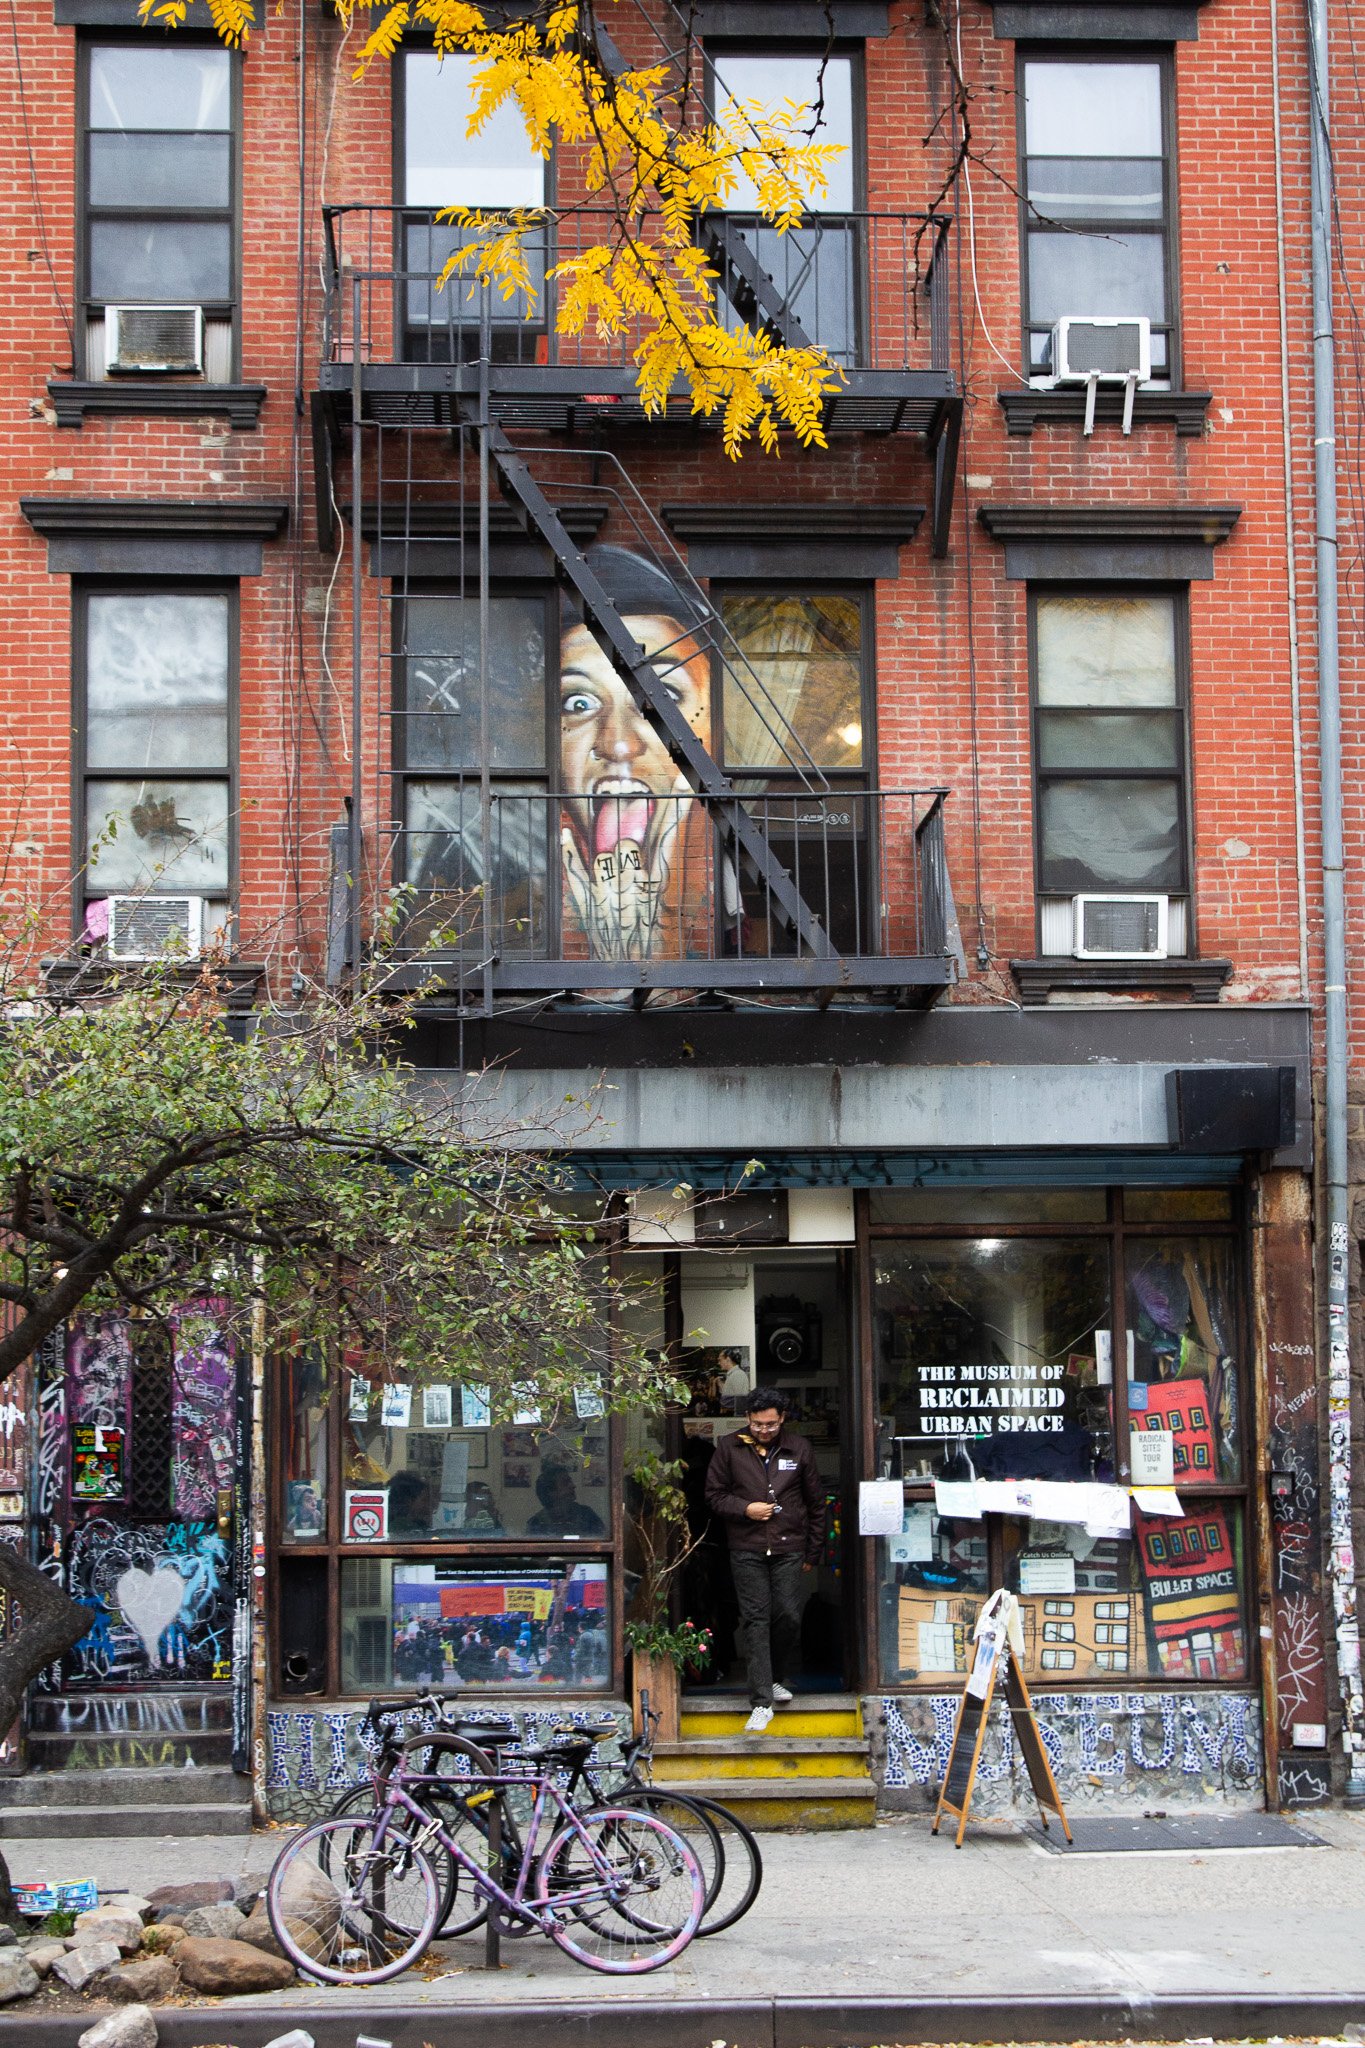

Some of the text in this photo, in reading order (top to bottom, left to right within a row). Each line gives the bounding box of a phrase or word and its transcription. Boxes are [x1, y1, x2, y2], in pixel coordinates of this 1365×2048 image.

[918, 1365, 1065, 1381] THE MUSEUM OF
[919, 1387, 1065, 1408] RECLAIMED
[920, 1415, 1064, 1433] URBAN SPACE
[1138, 1434, 1167, 1443] RADICAL
[1142, 1444, 1161, 1452] SITES
[1143, 1454, 1161, 1462] TOUR
[1150, 1571, 1234, 1598] BULLET SPACE
[882, 1694, 1256, 1790] MUSEUM
